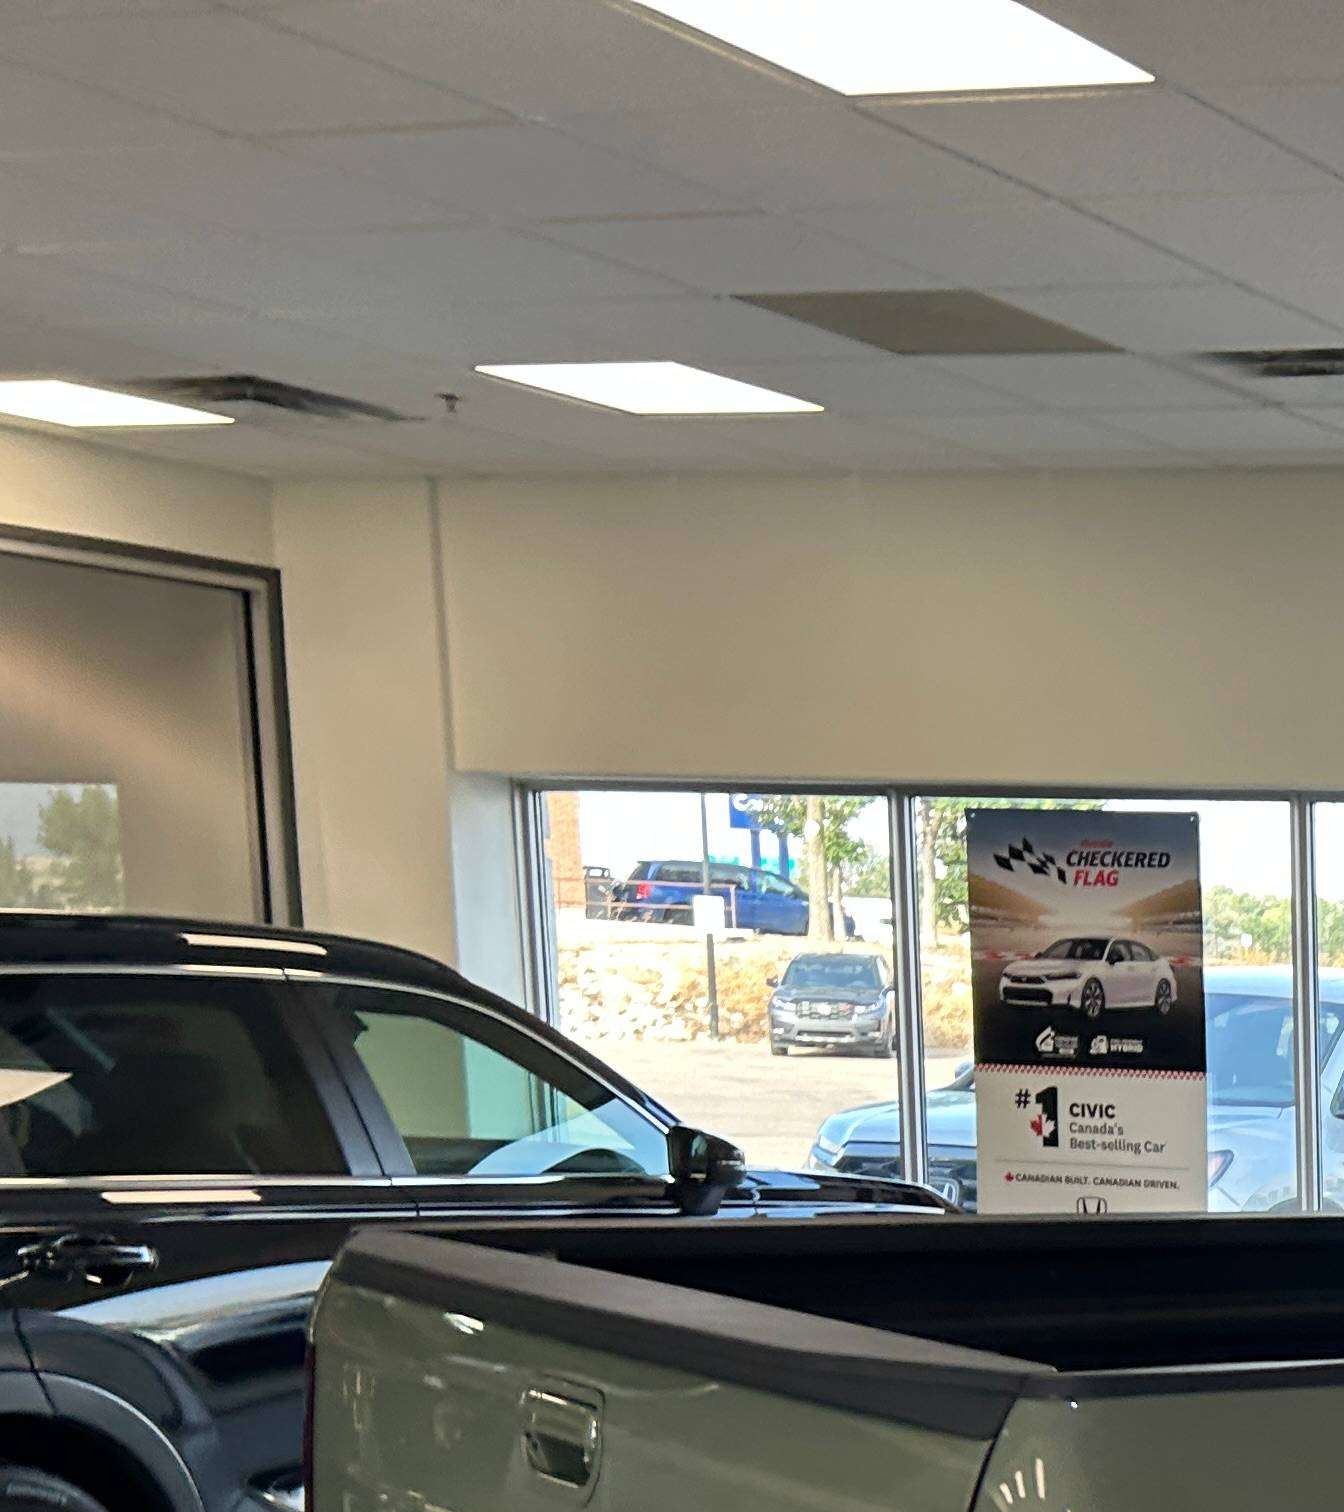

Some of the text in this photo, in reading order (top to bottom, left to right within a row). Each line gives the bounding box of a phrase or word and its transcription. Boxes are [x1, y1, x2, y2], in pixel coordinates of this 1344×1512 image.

[1066, 849, 1171, 868] CHECKERED
[1073, 868, 1120, 887] FLAG
[1069, 1103, 1116, 1119] CIVIC
[1069, 1121, 1124, 1136] Canada's
[1070, 1137, 1166, 1155] Best-selling Car
[1015, 1173, 1063, 1185] CANADIAN
[1093, 1176, 1141, 1188] CANADIAN
